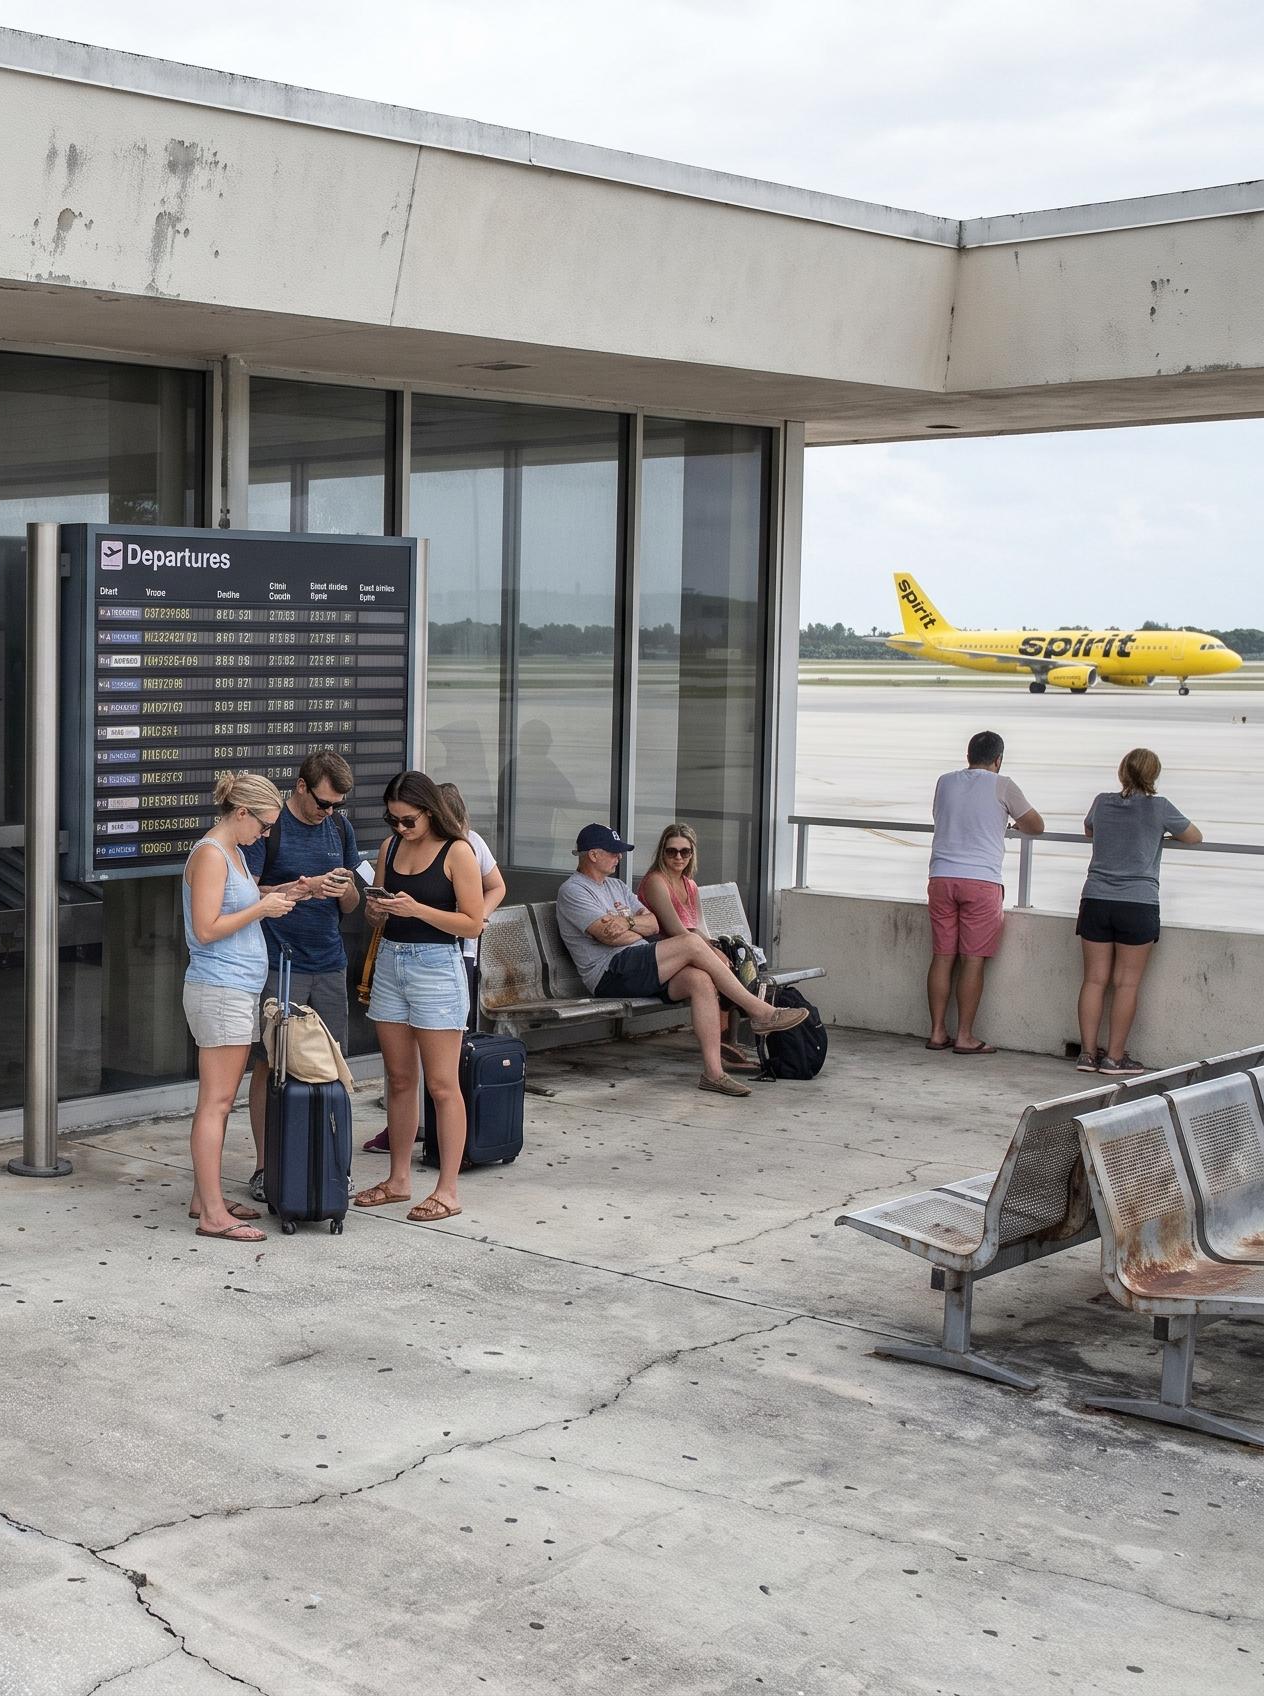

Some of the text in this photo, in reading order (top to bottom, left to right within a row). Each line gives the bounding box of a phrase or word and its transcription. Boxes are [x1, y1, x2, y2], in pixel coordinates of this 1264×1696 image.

[127, 543, 231, 571] Departures
[898, 578, 937, 630] spirit
[1018, 633, 1137, 658] spirit
